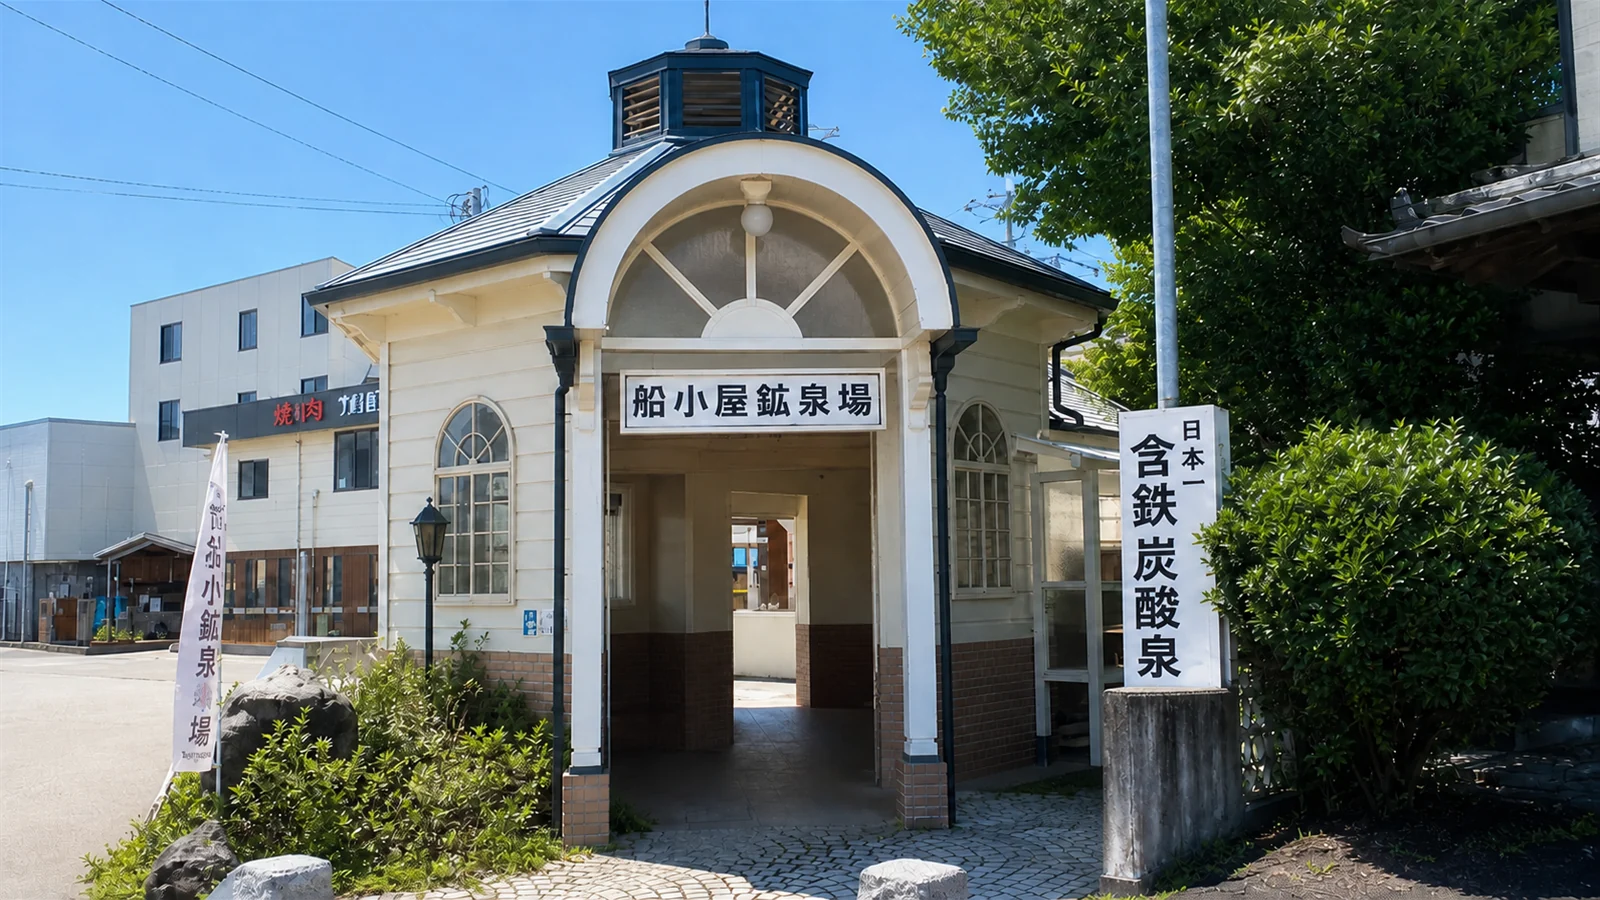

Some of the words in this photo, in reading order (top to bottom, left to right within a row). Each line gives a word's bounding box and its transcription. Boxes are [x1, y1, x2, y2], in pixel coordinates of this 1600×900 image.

[633, 383, 872, 418] 船小屋鉱泉場
[1181, 419, 1205, 486] 日本一
[1130, 433, 1182, 679] 含鉄炭酸泉
